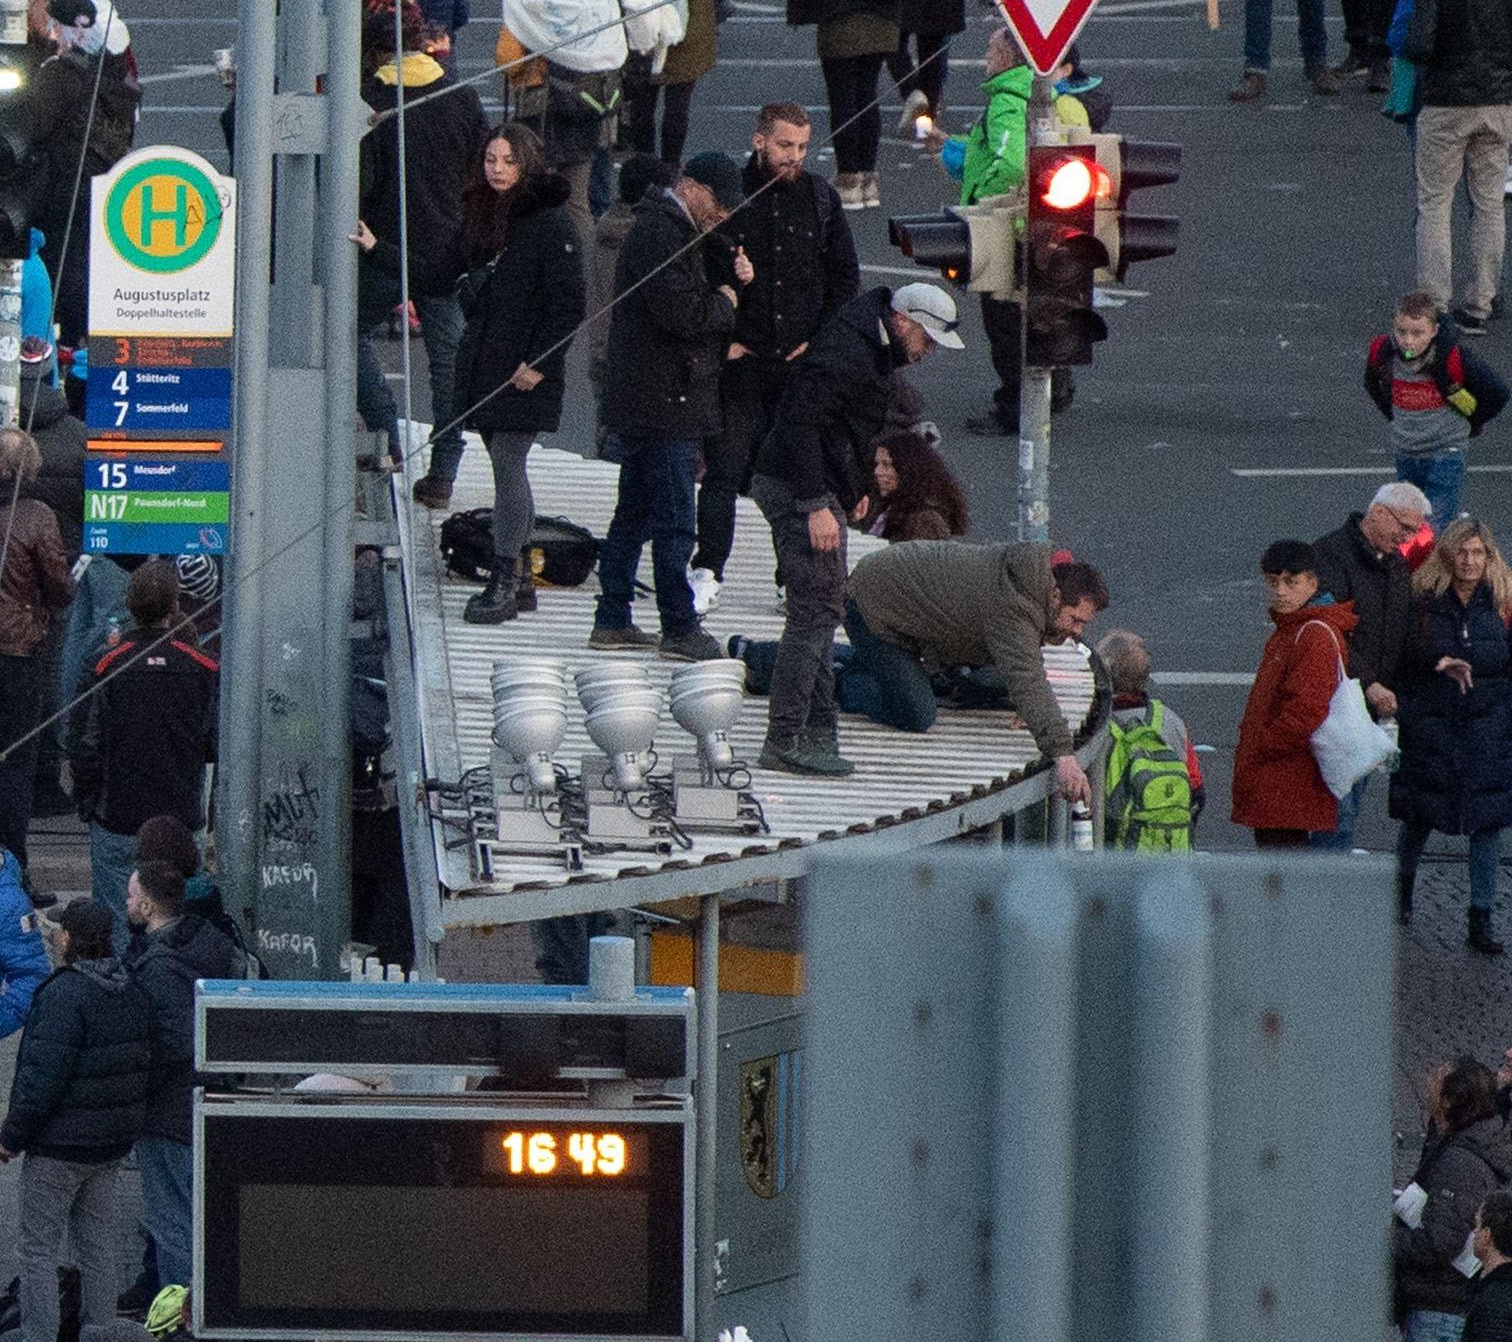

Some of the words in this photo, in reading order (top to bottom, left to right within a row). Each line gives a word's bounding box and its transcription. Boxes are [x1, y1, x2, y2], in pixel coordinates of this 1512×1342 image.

[113, 288, 210, 304] Augustusplatz
[116, 308, 207, 320] Doppelhaltestelle
[114, 338, 130, 365] 3
[112, 370, 130, 396] 4
[113, 401, 129, 426] 7
[135, 403, 189, 414] Sommerfeld
[98, 463, 128, 489] 15
[91, 494, 128, 520] N17
[90, 536, 109, 549] 110
